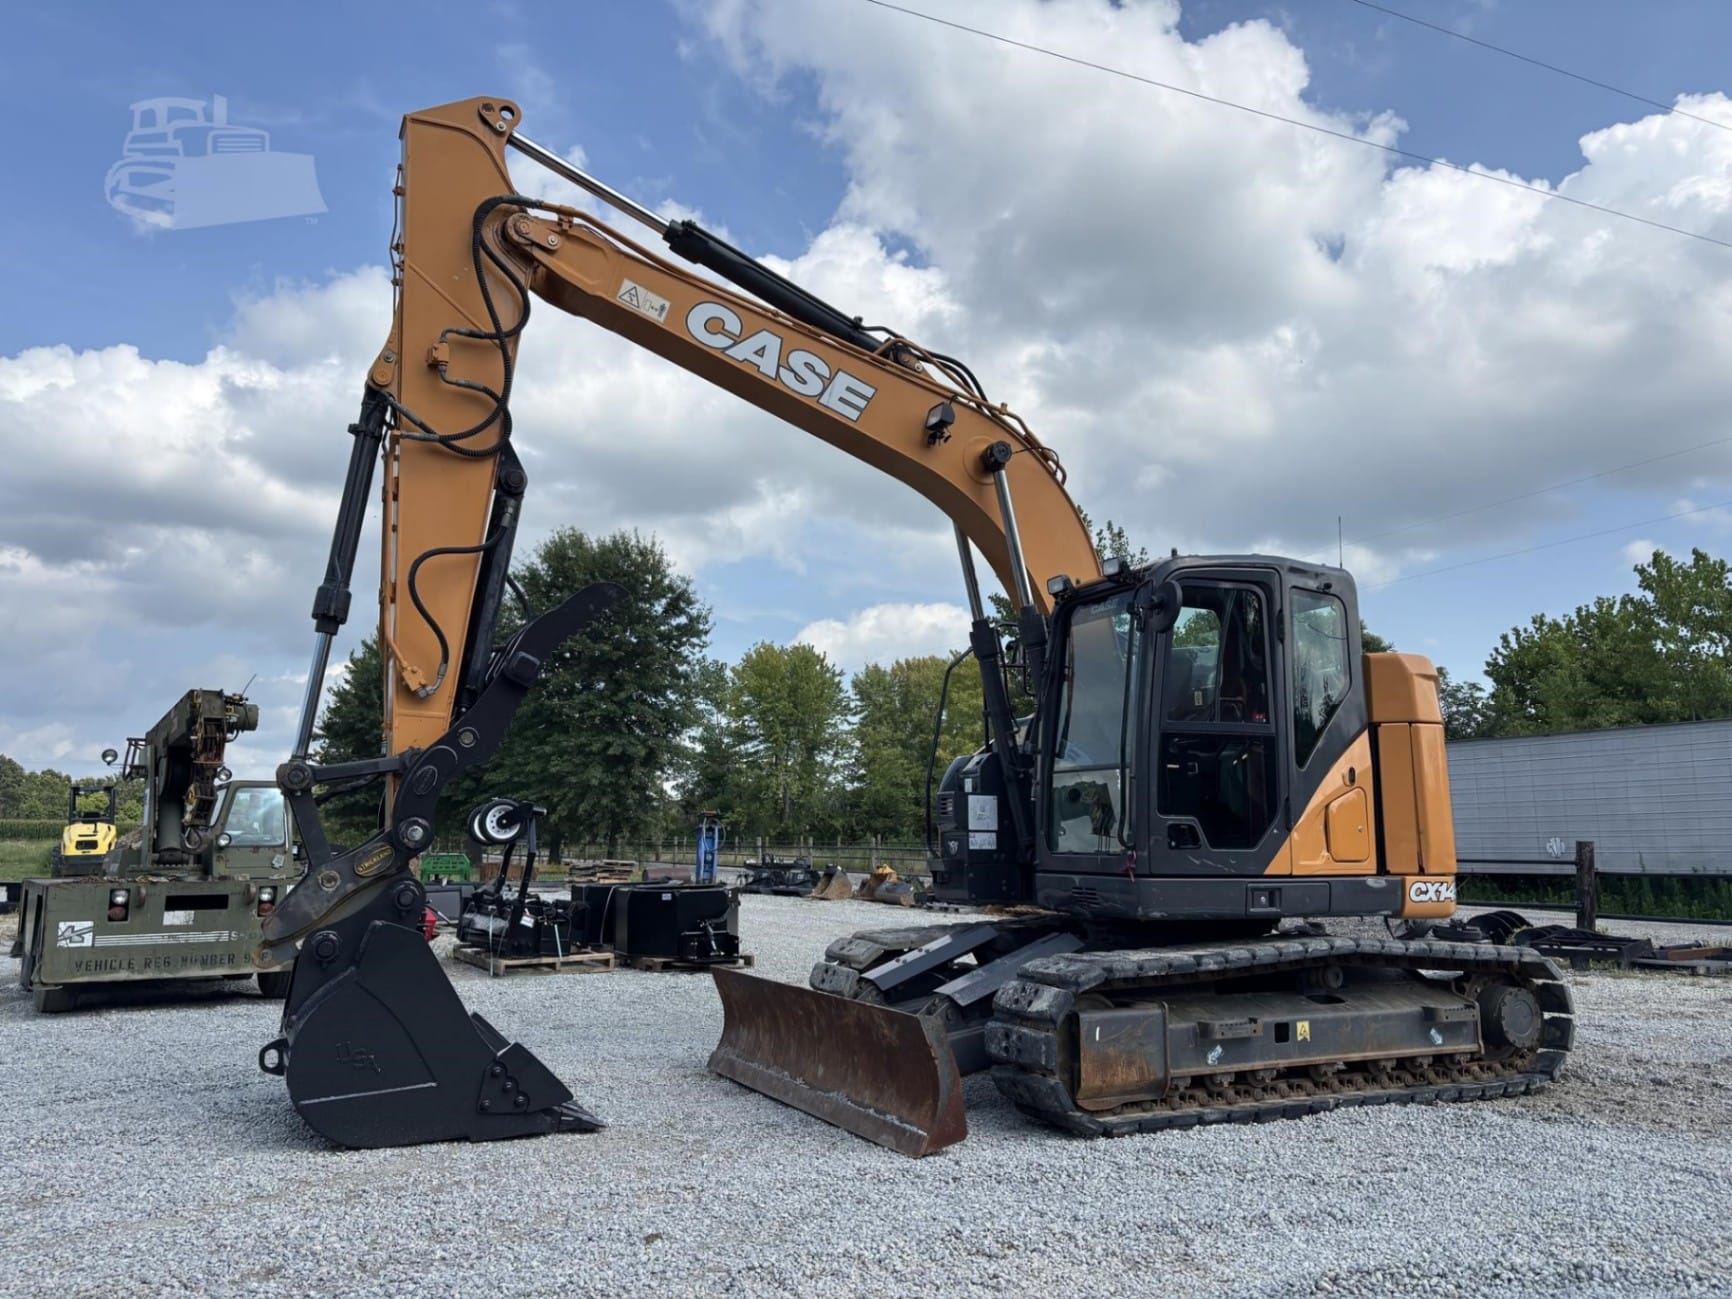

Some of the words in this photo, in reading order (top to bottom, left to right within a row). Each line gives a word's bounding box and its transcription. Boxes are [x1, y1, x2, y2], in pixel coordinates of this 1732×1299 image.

[685, 301, 878, 422] CASE
[1409, 881, 1456, 903] CX14
[74, 958, 135, 972] VEHICLE
[144, 955, 171, 969] REG
[177, 953, 236, 967] NUMBER
